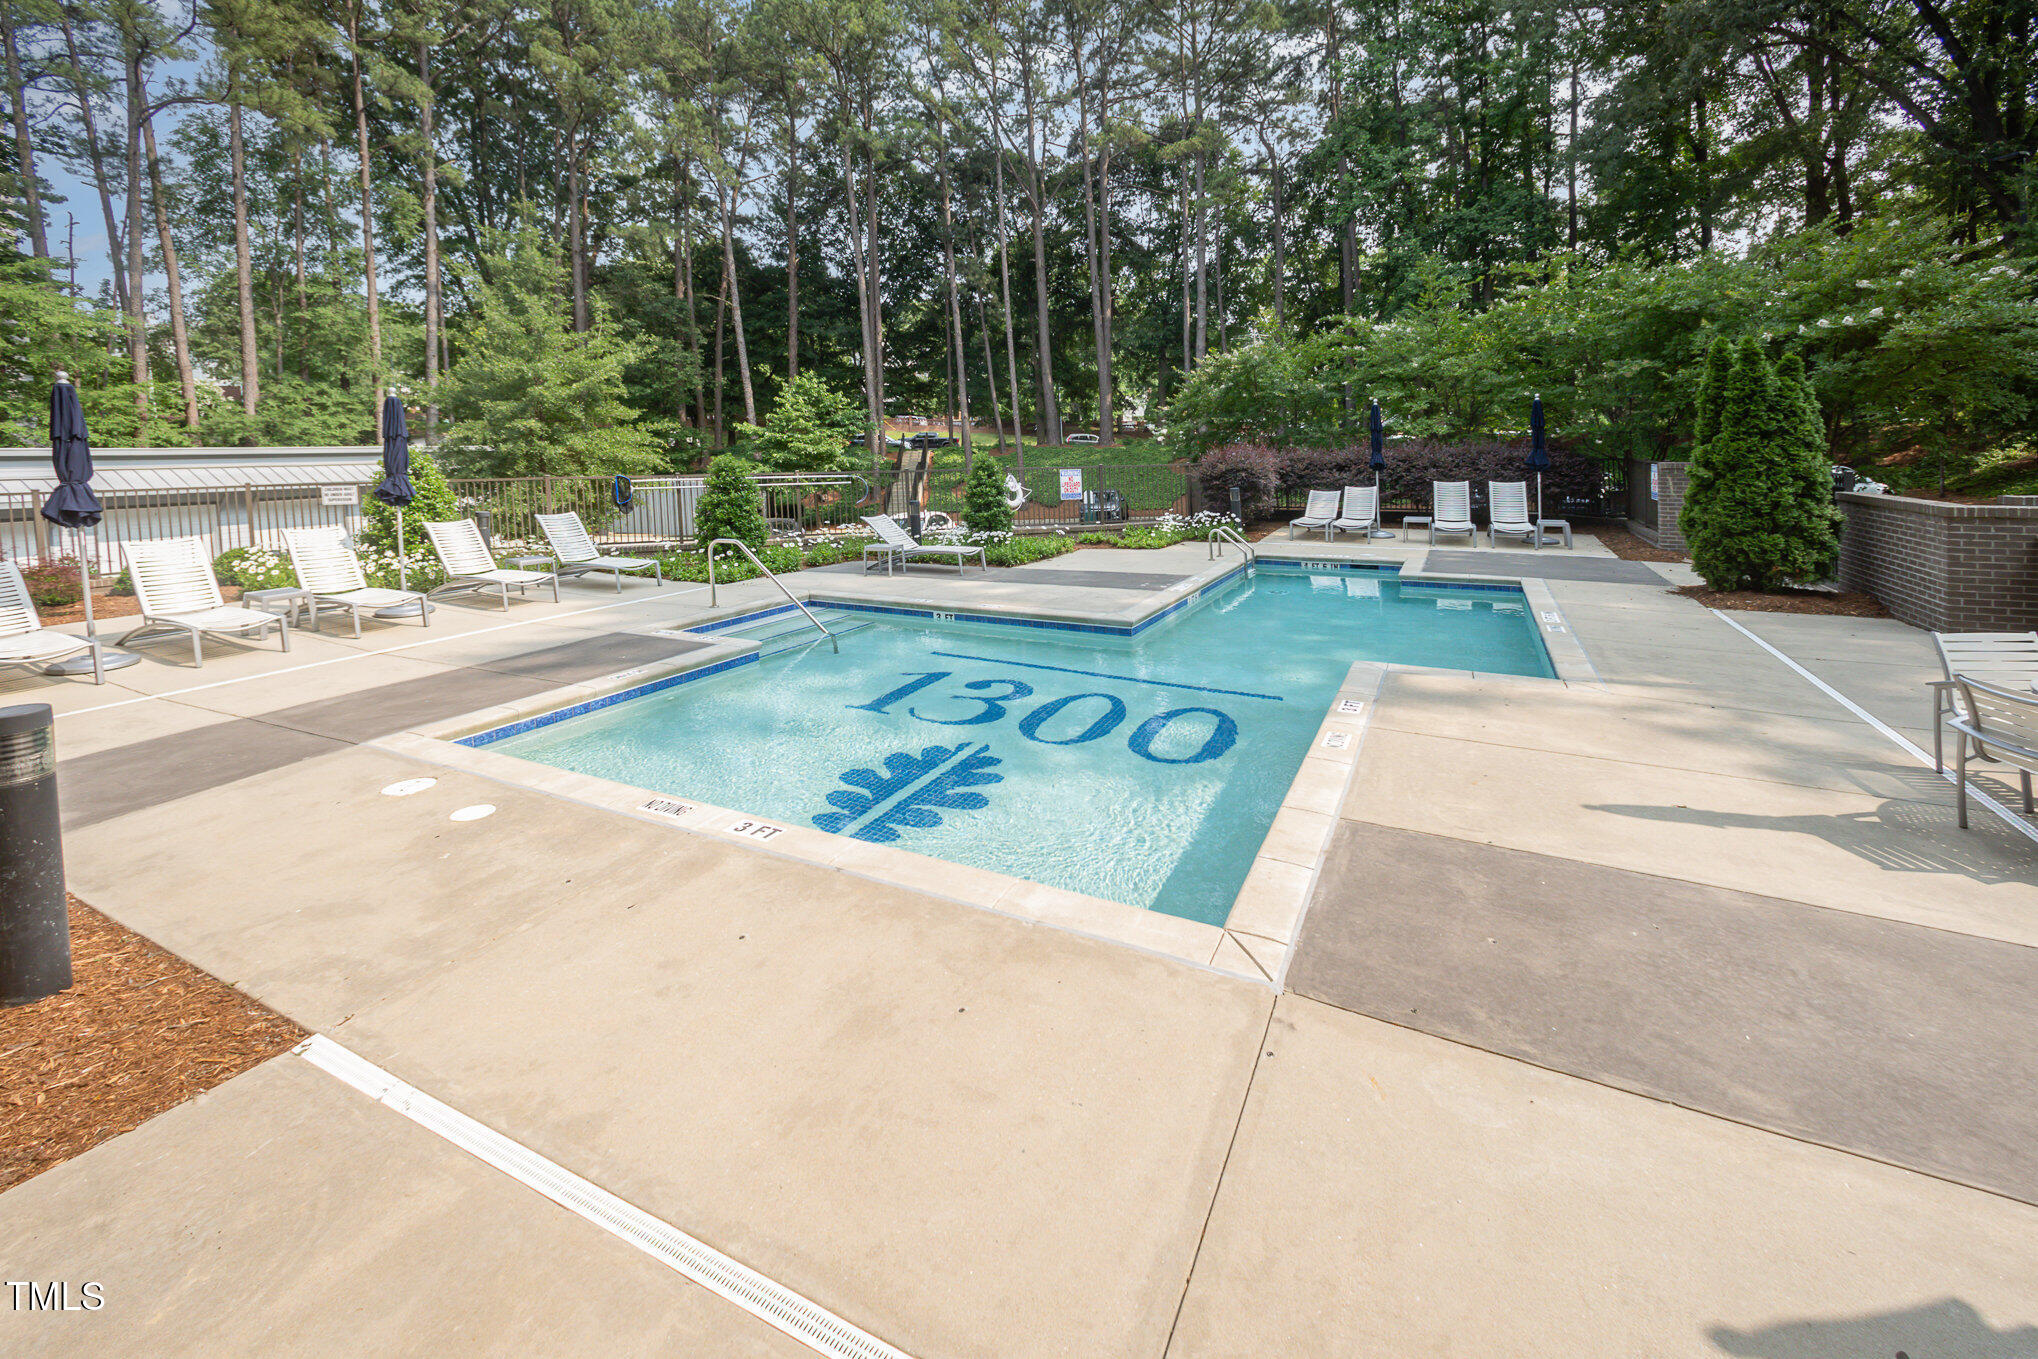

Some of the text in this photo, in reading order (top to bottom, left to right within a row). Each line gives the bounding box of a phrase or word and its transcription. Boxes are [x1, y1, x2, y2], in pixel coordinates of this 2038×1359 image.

[845, 671, 1238, 764] 1300
[733, 822, 783, 839] 3 FT
